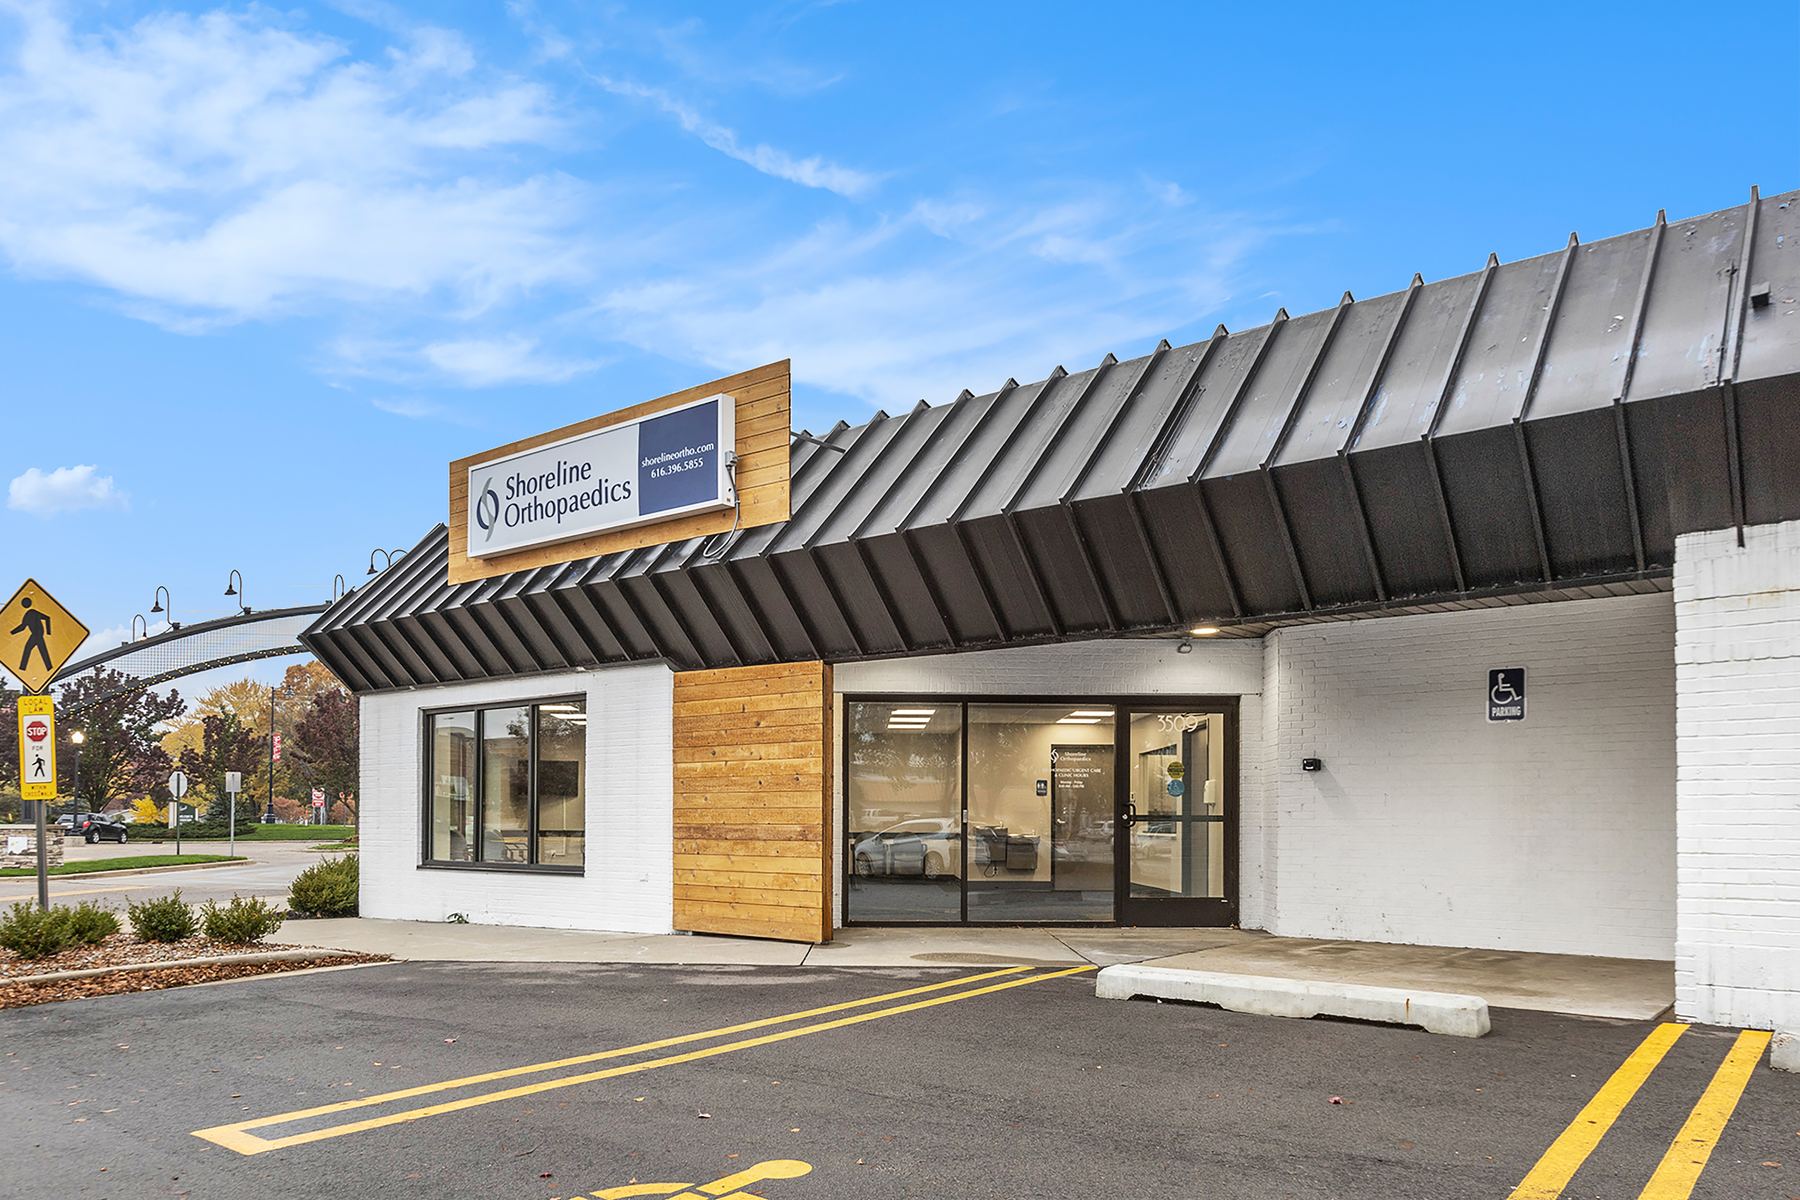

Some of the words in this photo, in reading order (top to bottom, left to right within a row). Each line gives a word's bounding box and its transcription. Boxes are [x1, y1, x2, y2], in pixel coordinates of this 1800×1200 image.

[641, 442, 715, 468] shorelineortho.com
[650, 457, 704, 479] 616.396.5855
[505, 460, 592, 501] Shoreline
[504, 478, 632, 528] Orthopaedics
[23, 698, 48, 706] LOCAL
[1491, 706, 1522, 717] PARKING
[27, 726, 48, 737] STOP
[1157, 714, 1198, 733] 3509
